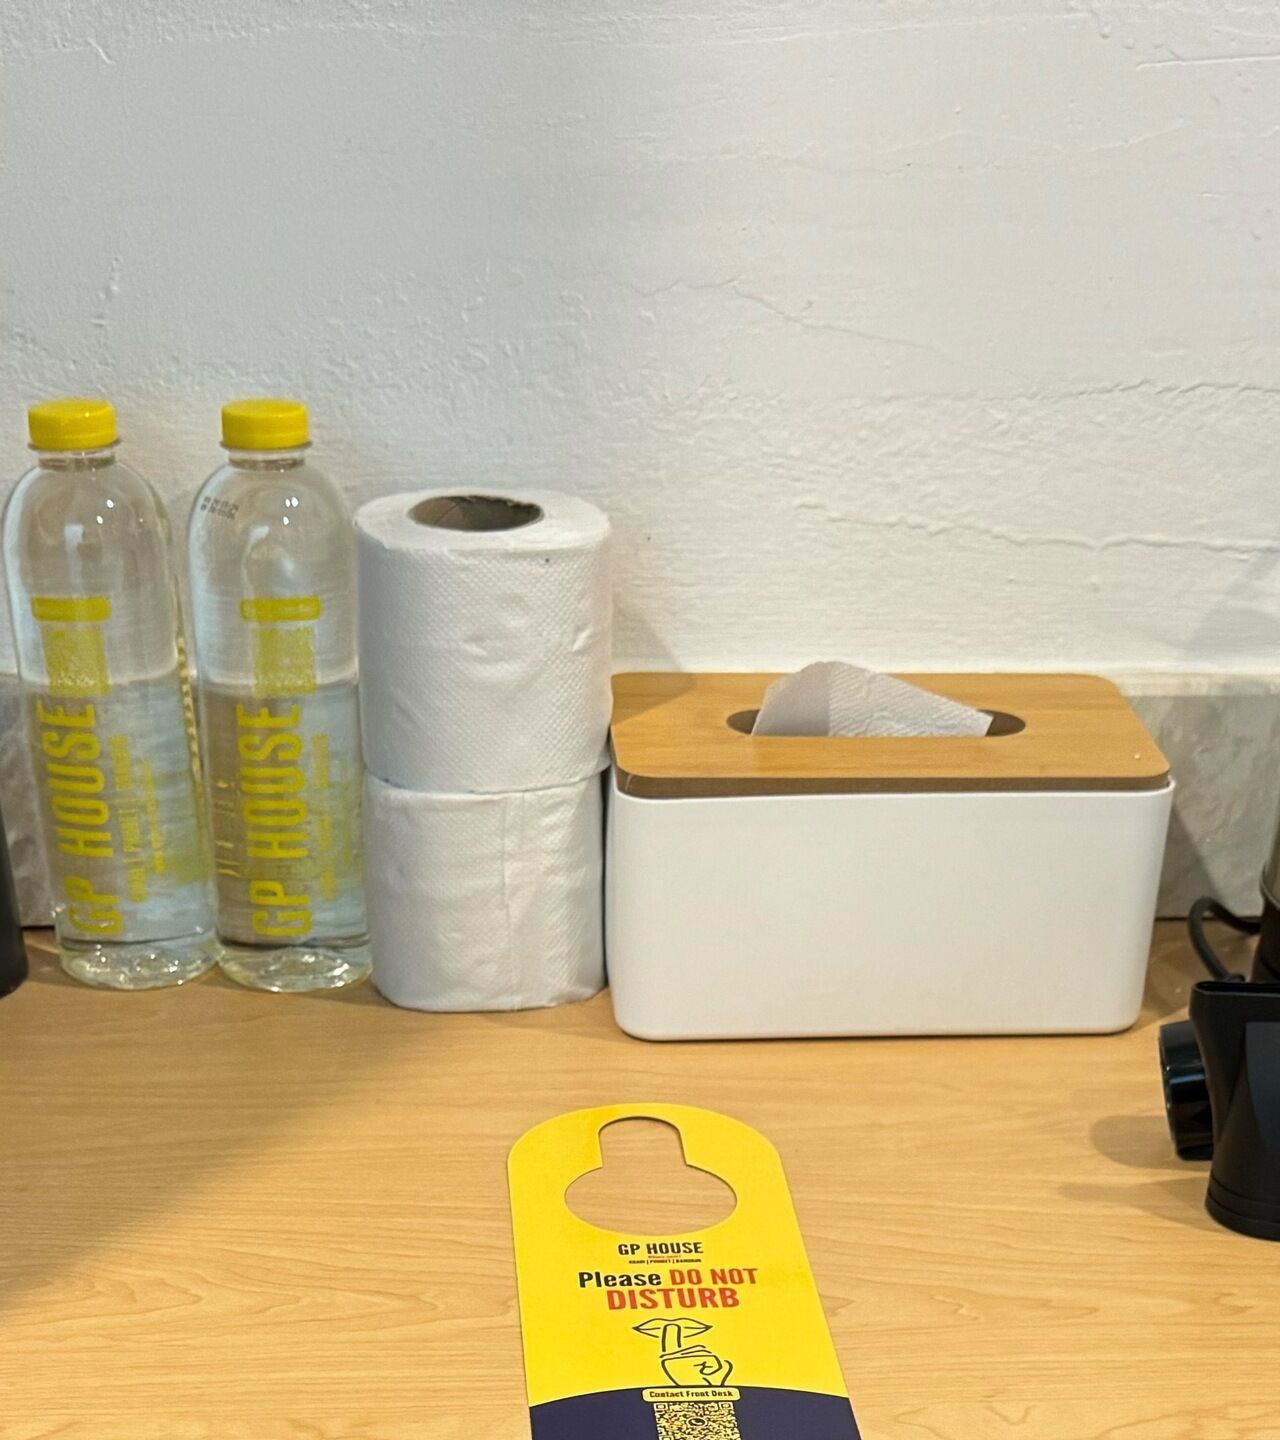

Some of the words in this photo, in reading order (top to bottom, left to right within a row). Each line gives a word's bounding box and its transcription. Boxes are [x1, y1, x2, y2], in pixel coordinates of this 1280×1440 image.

[37, 699, 114, 858] HOUSE
[236, 704, 311, 859] HOUSE
[64, 874, 124, 937] GP
[248, 879, 313, 938] GP
[617, 1243, 641, 1256] GP
[646, 1241, 704, 1255] HOUSE
[578, 1271, 662, 1289] Please
[669, 1268, 703, 1286] DO
[709, 1267, 758, 1286] NOT
[606, 1287, 740, 1311] DISTURB
[649, 1390, 685, 1398] Contact
[686, 1390, 710, 1398] Front
[711, 1389, 734, 1397] Desk
